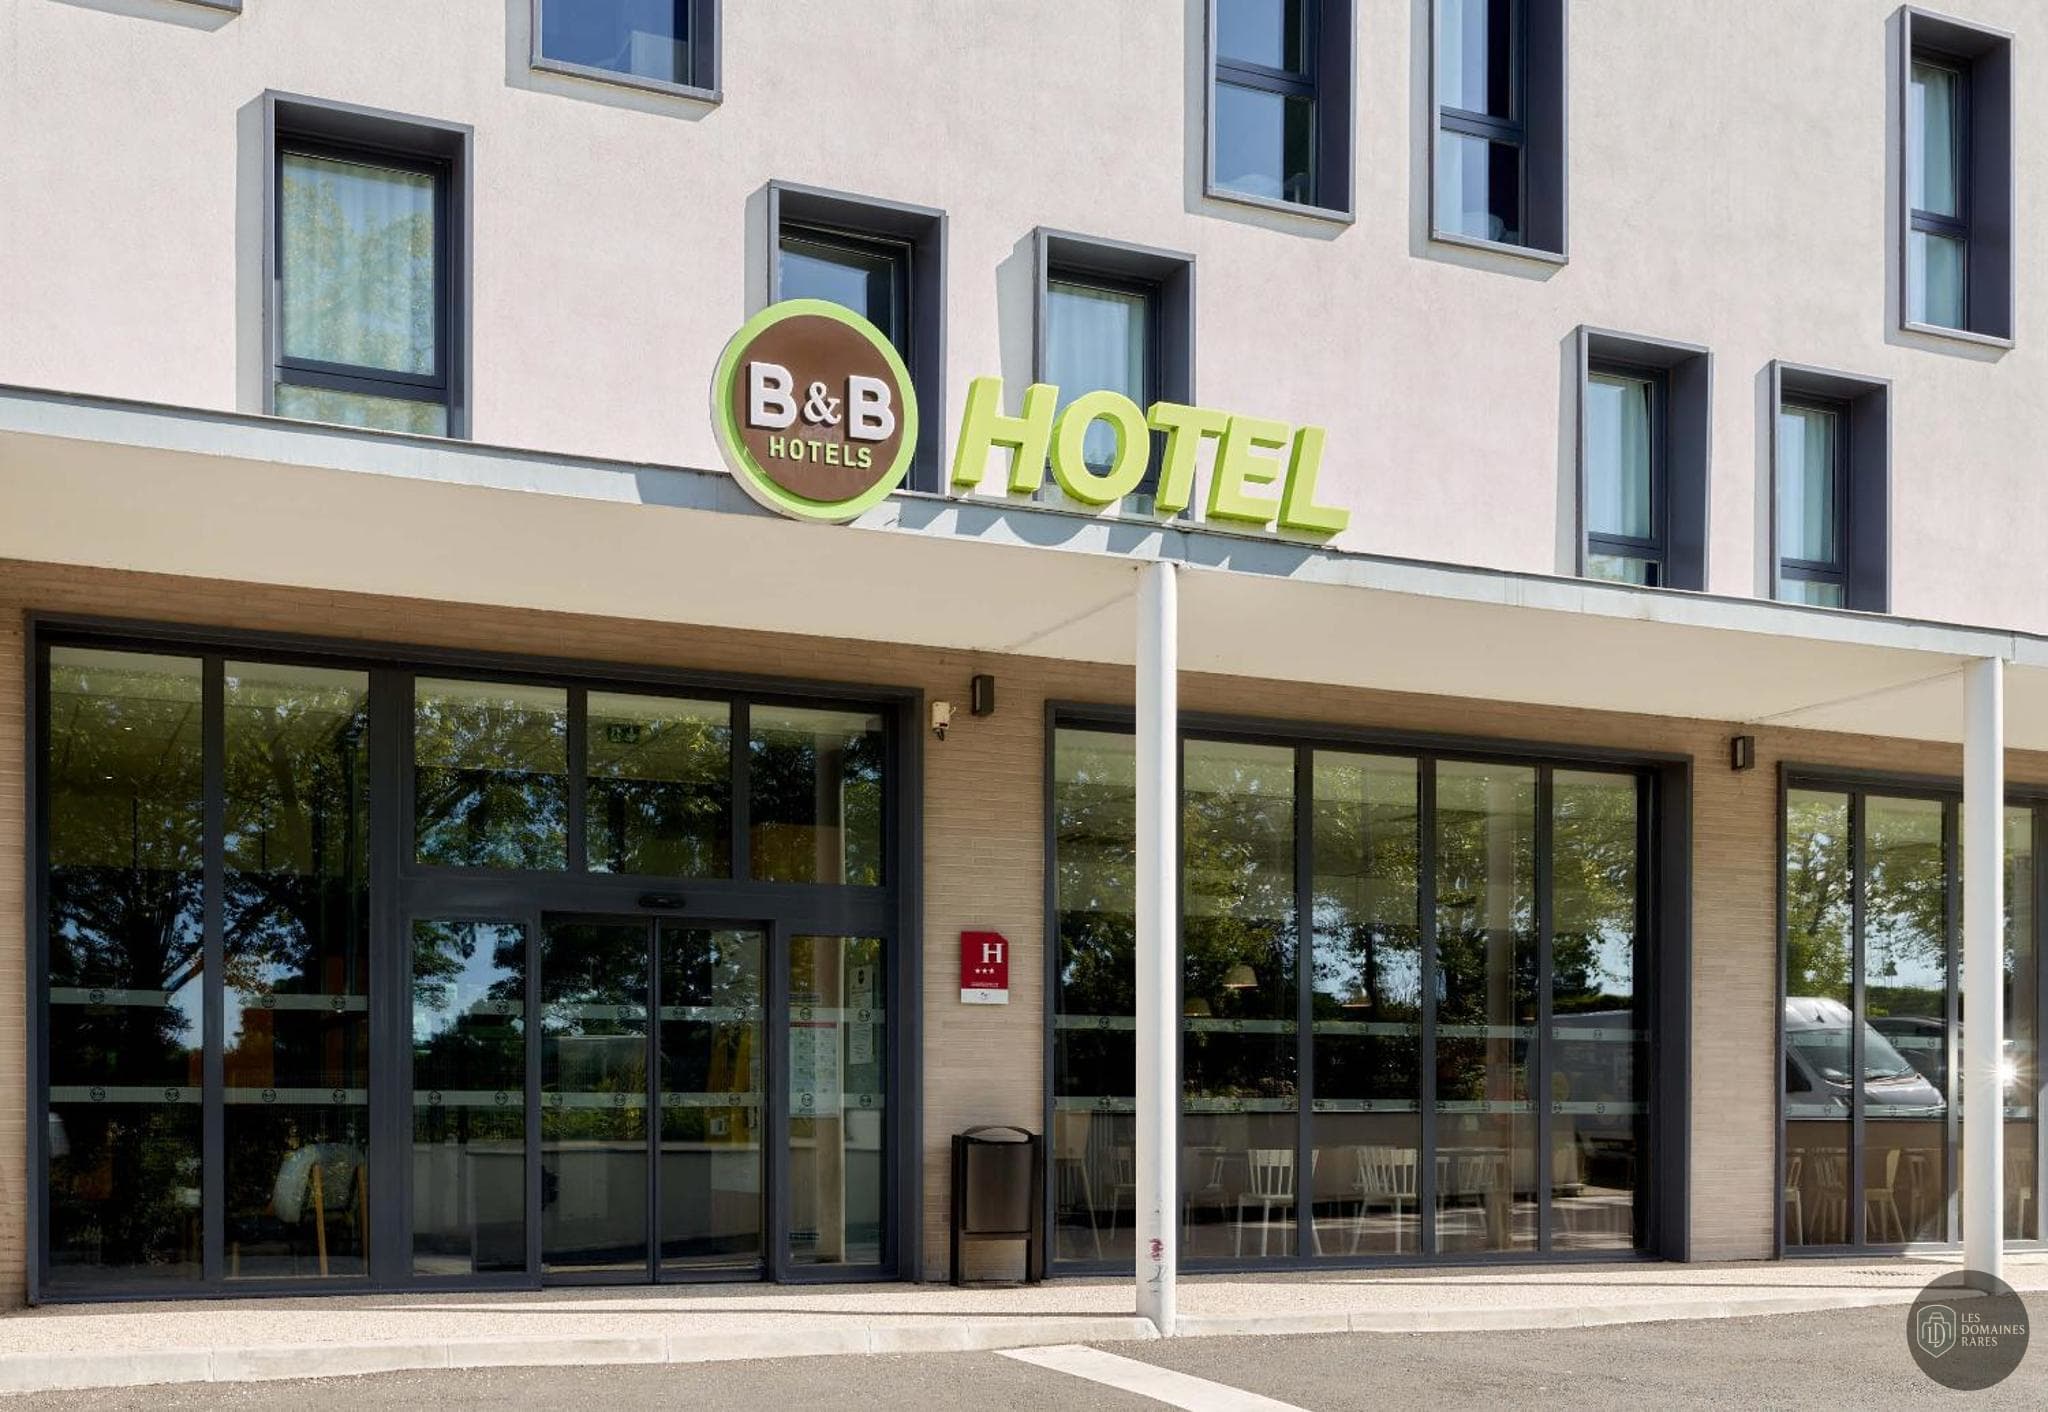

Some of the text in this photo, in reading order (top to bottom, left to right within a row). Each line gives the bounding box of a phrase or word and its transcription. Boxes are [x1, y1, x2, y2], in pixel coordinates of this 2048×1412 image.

[748, 361, 896, 441] B&B
[768, 435, 872, 470] HOTELS
[951, 375, 1351, 533] HOTEL
[982, 943, 1003, 964] H
